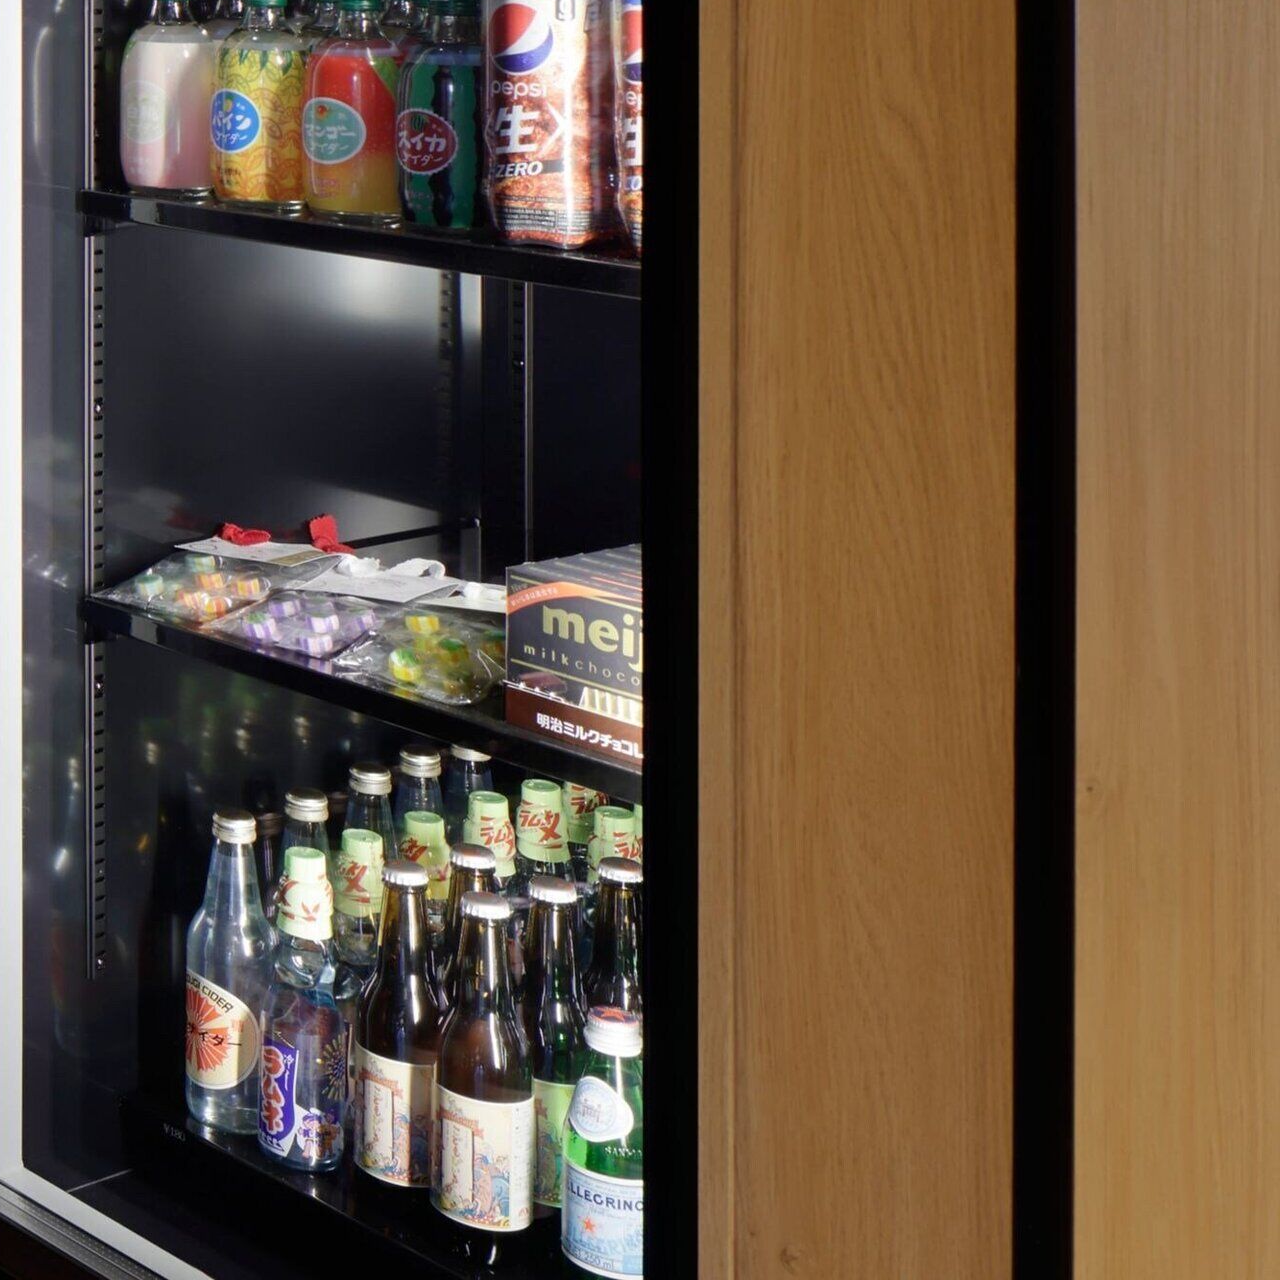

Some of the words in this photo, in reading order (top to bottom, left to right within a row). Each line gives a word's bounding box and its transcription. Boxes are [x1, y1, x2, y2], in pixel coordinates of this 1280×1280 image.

[490, 79, 548, 100] pepsi
[397, 130, 447, 153] スイカ
[495, 105, 540, 155] 生
[494, 160, 544, 179] ZERO
[202, 987, 234, 1013] CIDER
